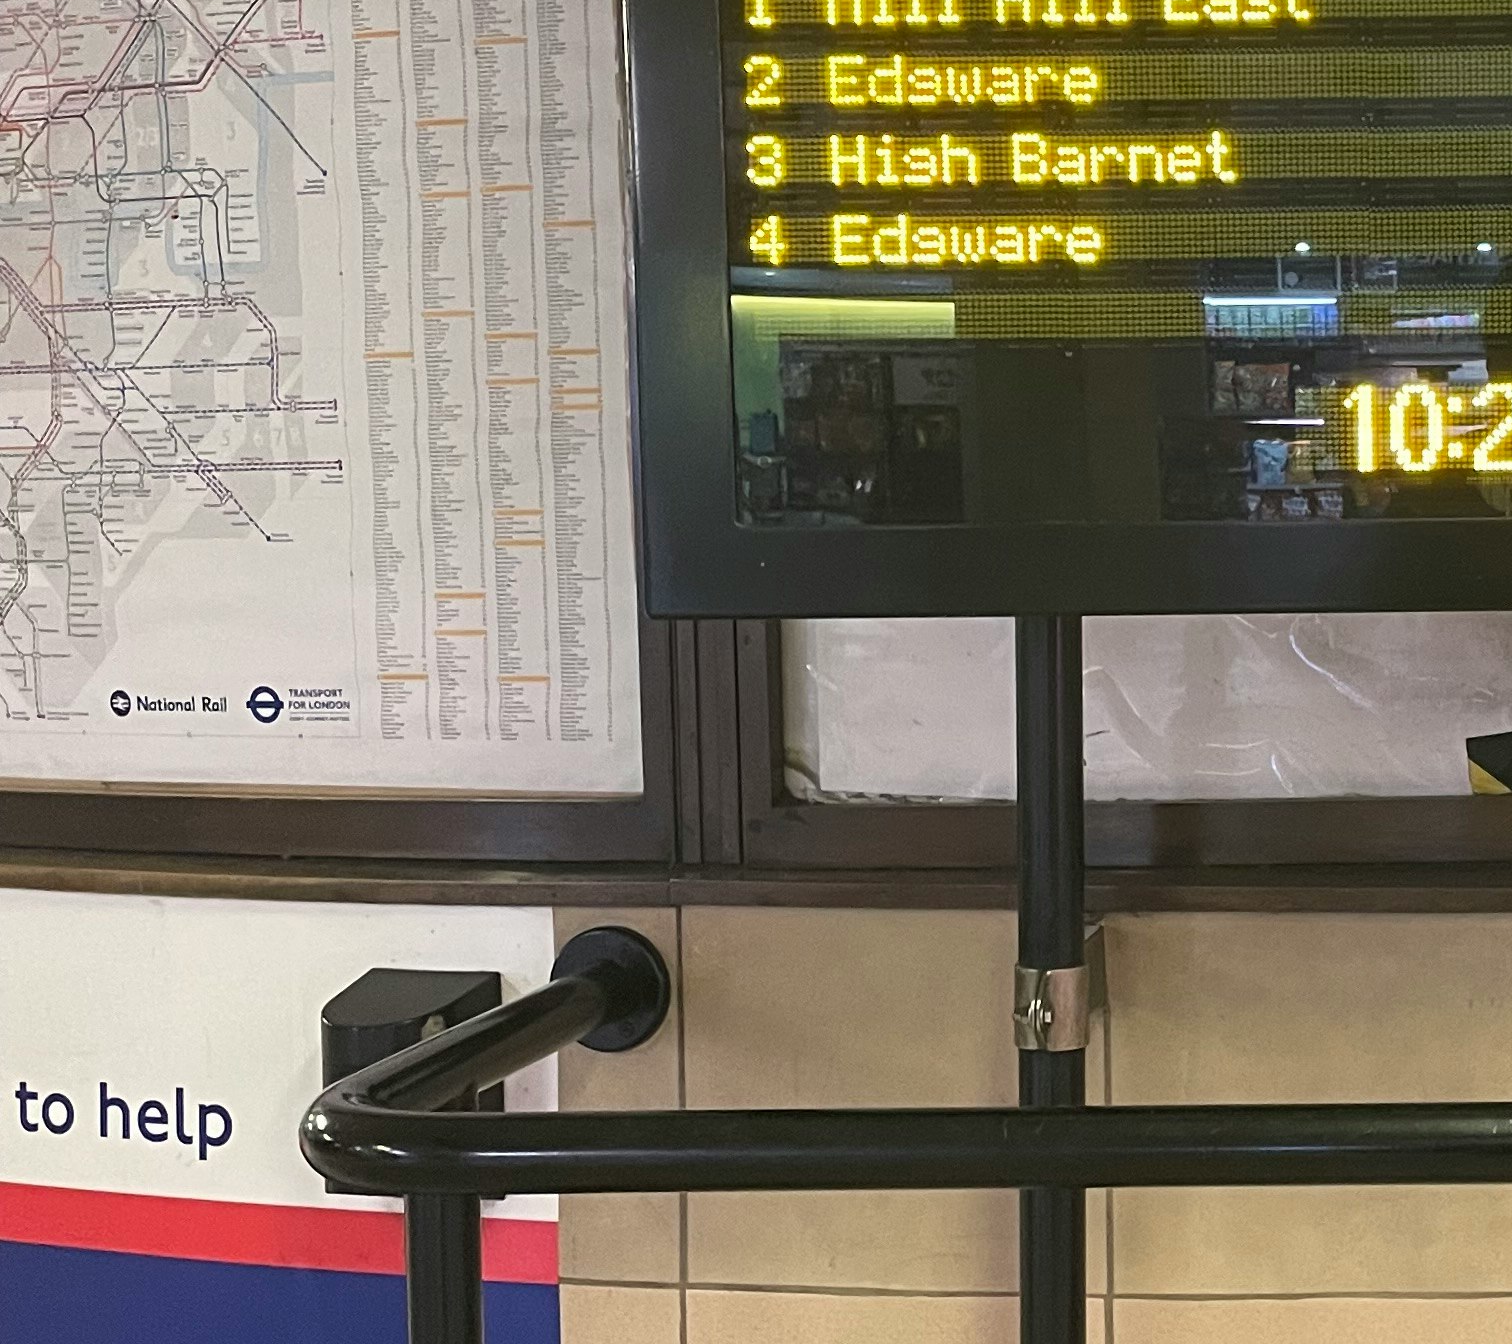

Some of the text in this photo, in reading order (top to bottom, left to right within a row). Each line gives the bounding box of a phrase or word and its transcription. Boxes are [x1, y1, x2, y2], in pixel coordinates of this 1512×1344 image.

[742, 54, 784, 107] 2
[826, 53, 1100, 106] Edgware
[744, 134, 786, 187] 3
[827, 132, 979, 187] High
[1010, 129, 1238, 185] Barnet
[748, 214, 787, 266] 4
[829, 212, 1103, 265] Edgware
[136, 696, 228, 713] National Rail
[288, 688, 343, 698] TRANSPORT
[288, 700, 351, 710] FOR LONDON
[14, 1081, 234, 1161] to help
